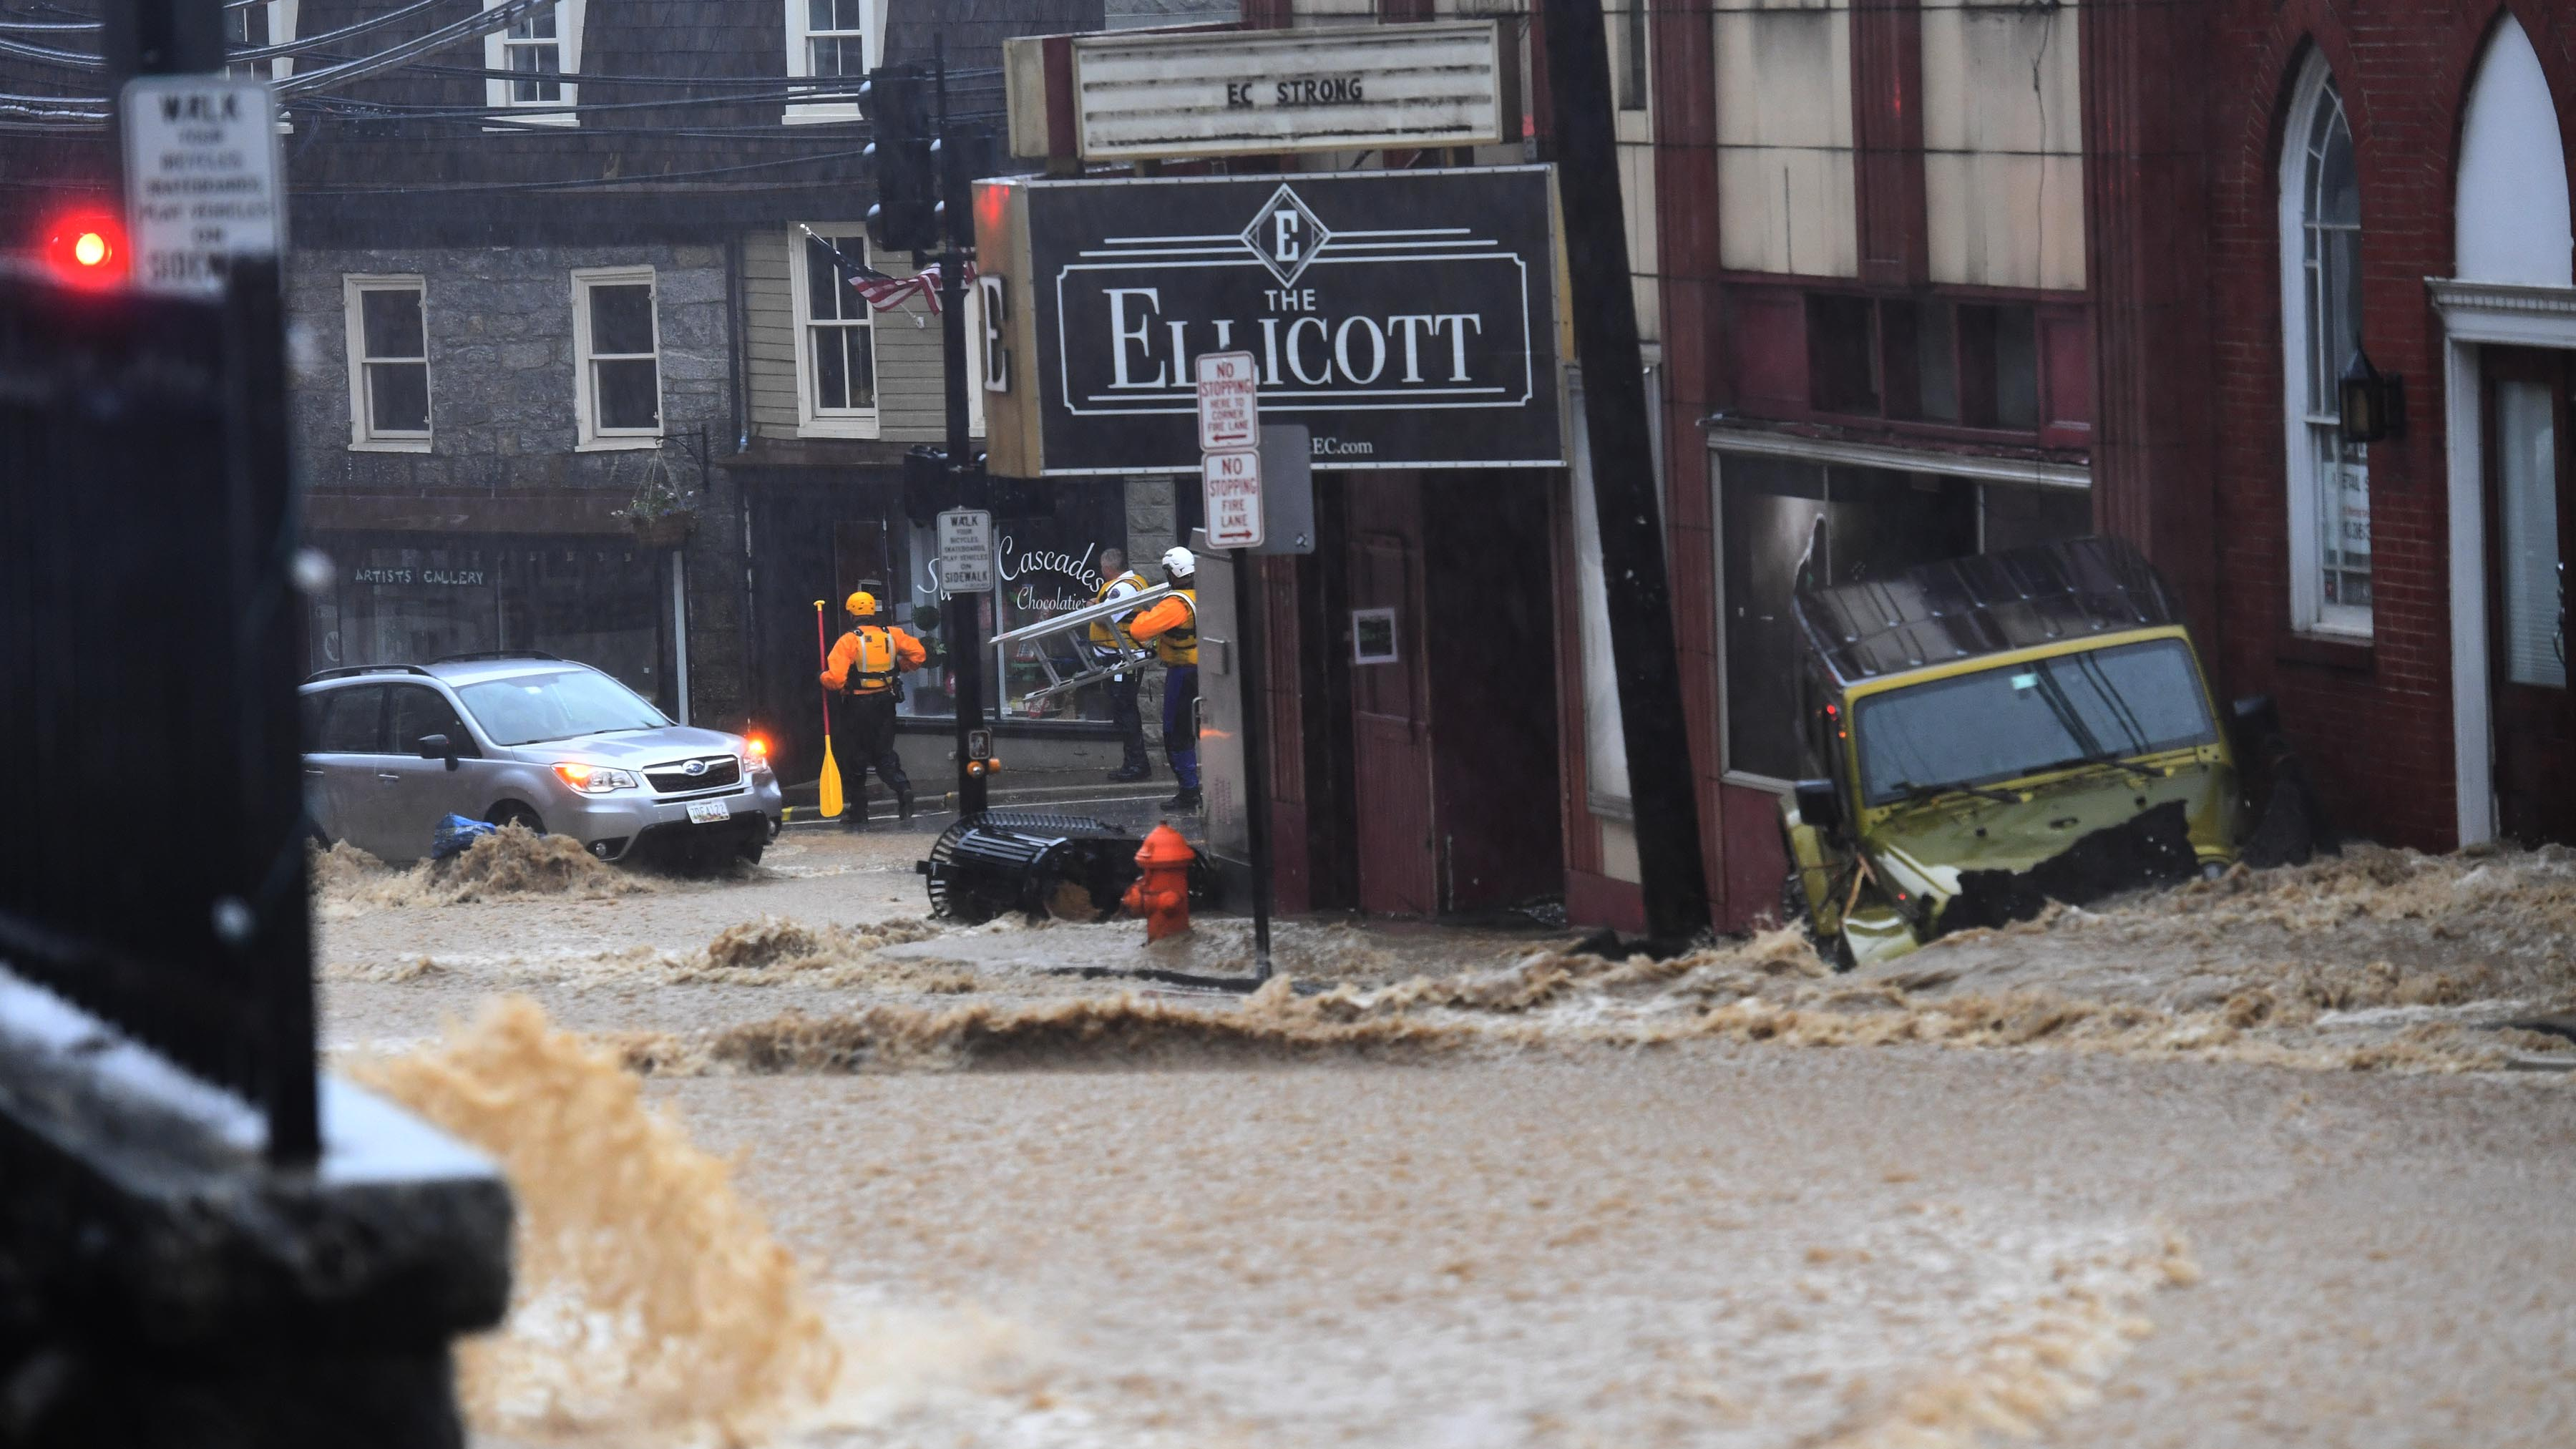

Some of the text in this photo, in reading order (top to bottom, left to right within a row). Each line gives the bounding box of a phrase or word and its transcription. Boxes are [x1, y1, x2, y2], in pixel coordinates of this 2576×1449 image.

[1227, 78, 1362, 104] EC STRONG
[1274, 210, 1299, 262] E
[1264, 289, 1317, 312] THE
[979, 276, 1007, 392] E
[1217, 363, 1234, 378] NO
[1202, 379, 1252, 396] STOPPING
[1310, 436, 1373, 454] EC.com
[1222, 458, 1242, 475] NO
[1209, 477, 1256, 497] STOPPING
[1222, 499, 1244, 512] FIRE
[950, 516, 978, 527] WALK
[1221, 514, 1247, 528] LANE
[998, 535, 1105, 592] Cascades
[356, 568, 412, 584] ARTISTS
[945, 572, 987, 583] SIDEWALK
